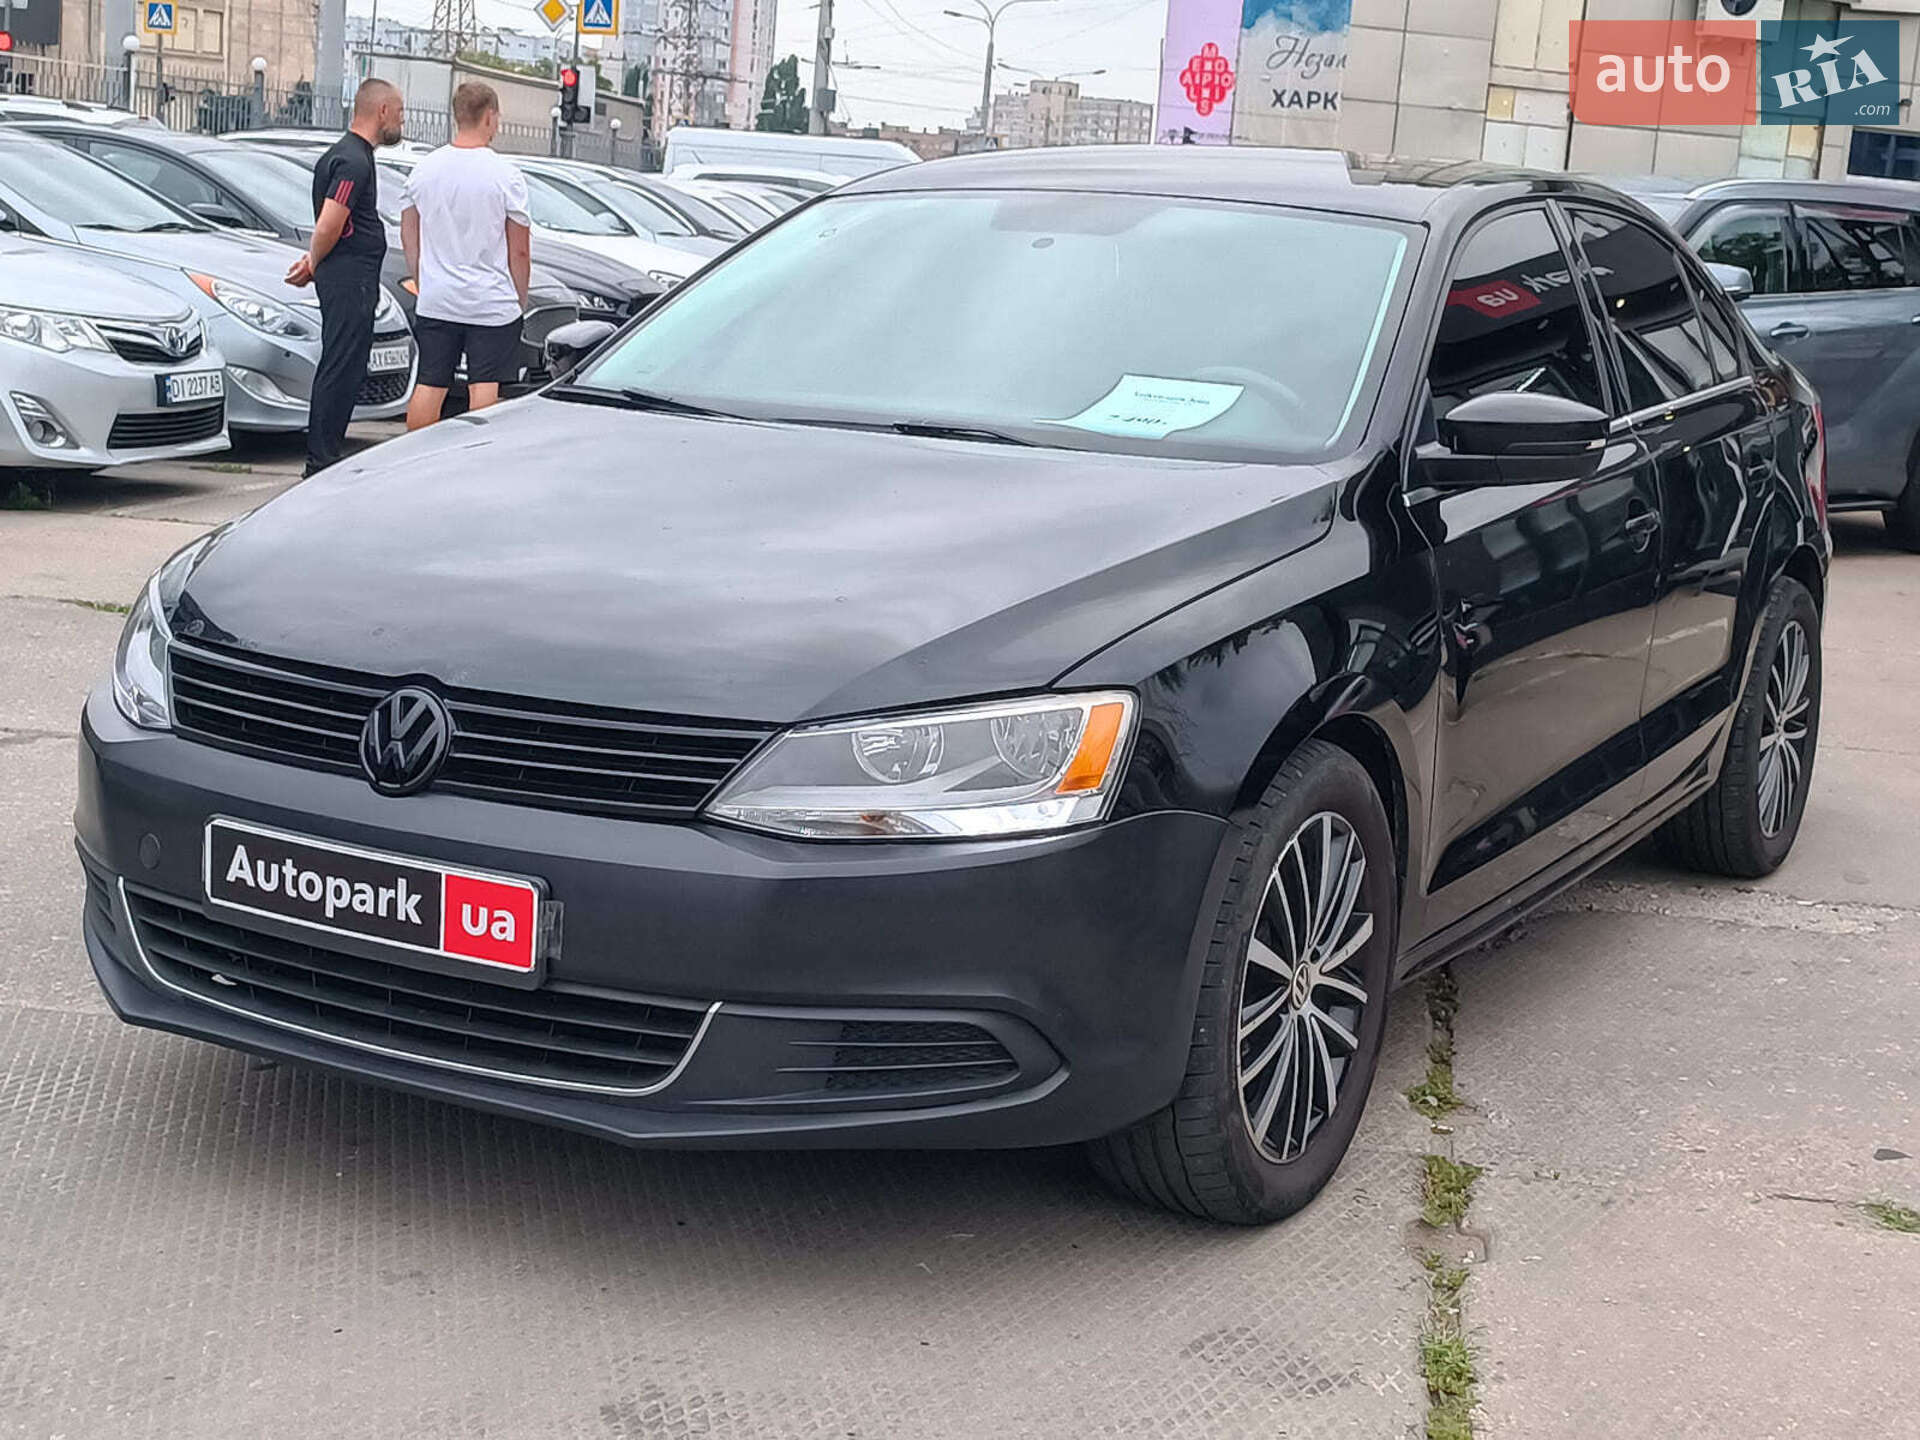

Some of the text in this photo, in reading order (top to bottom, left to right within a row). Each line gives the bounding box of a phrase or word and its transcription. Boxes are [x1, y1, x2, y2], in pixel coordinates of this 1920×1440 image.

[187, 376, 208, 396] 2237
[225, 844, 517, 942] Autopark ua
